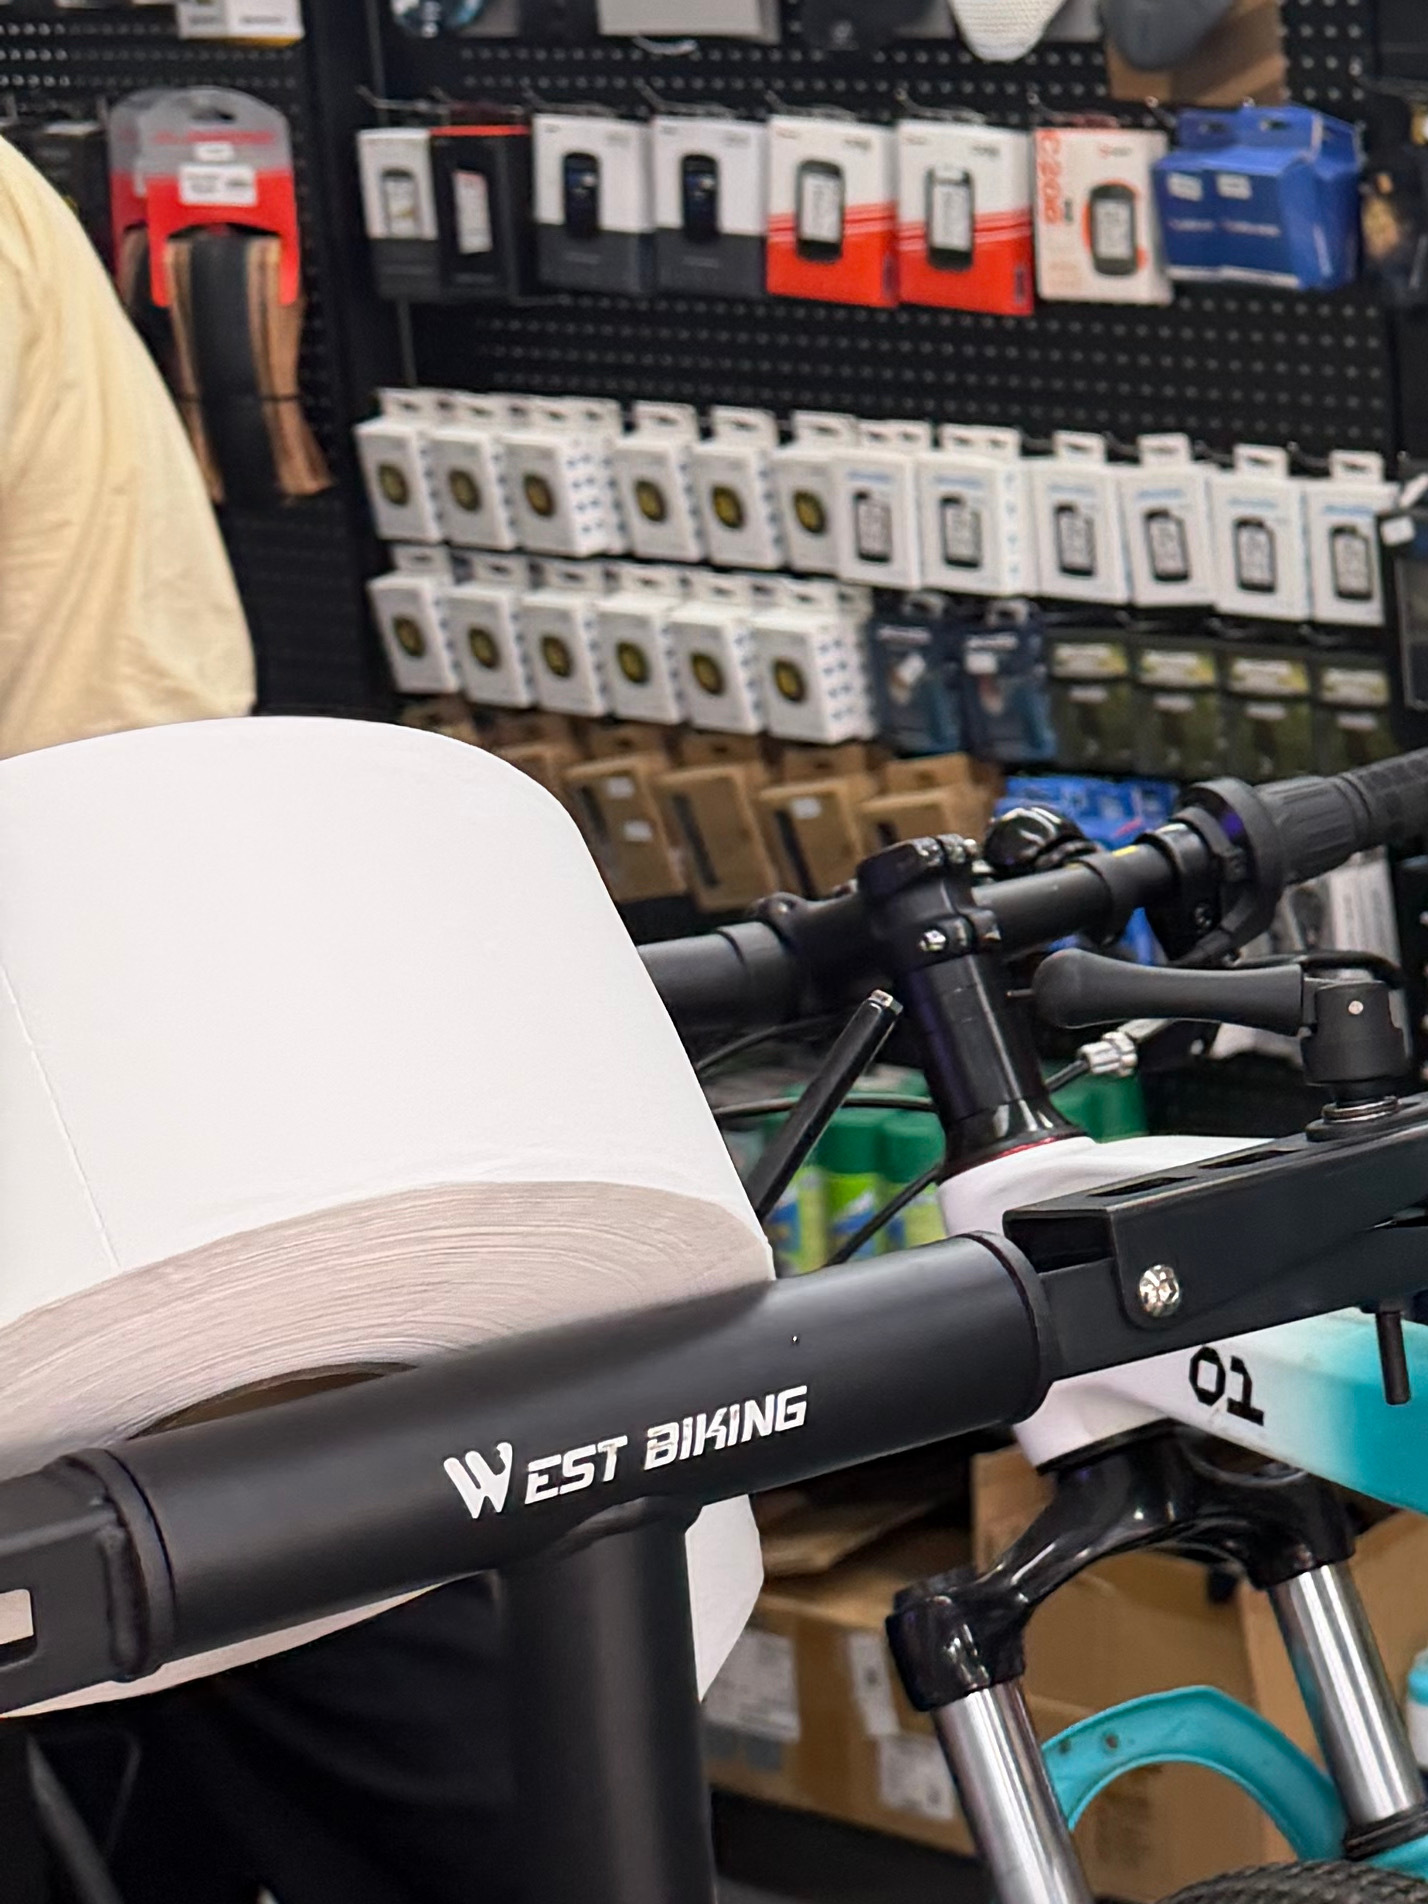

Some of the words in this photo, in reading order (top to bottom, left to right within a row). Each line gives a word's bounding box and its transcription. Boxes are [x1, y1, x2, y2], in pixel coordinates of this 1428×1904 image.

[1188, 1346, 1264, 1427] 01
[443, 1434, 629, 1520] WEST
[644, 1384, 808, 1472] BIKING
